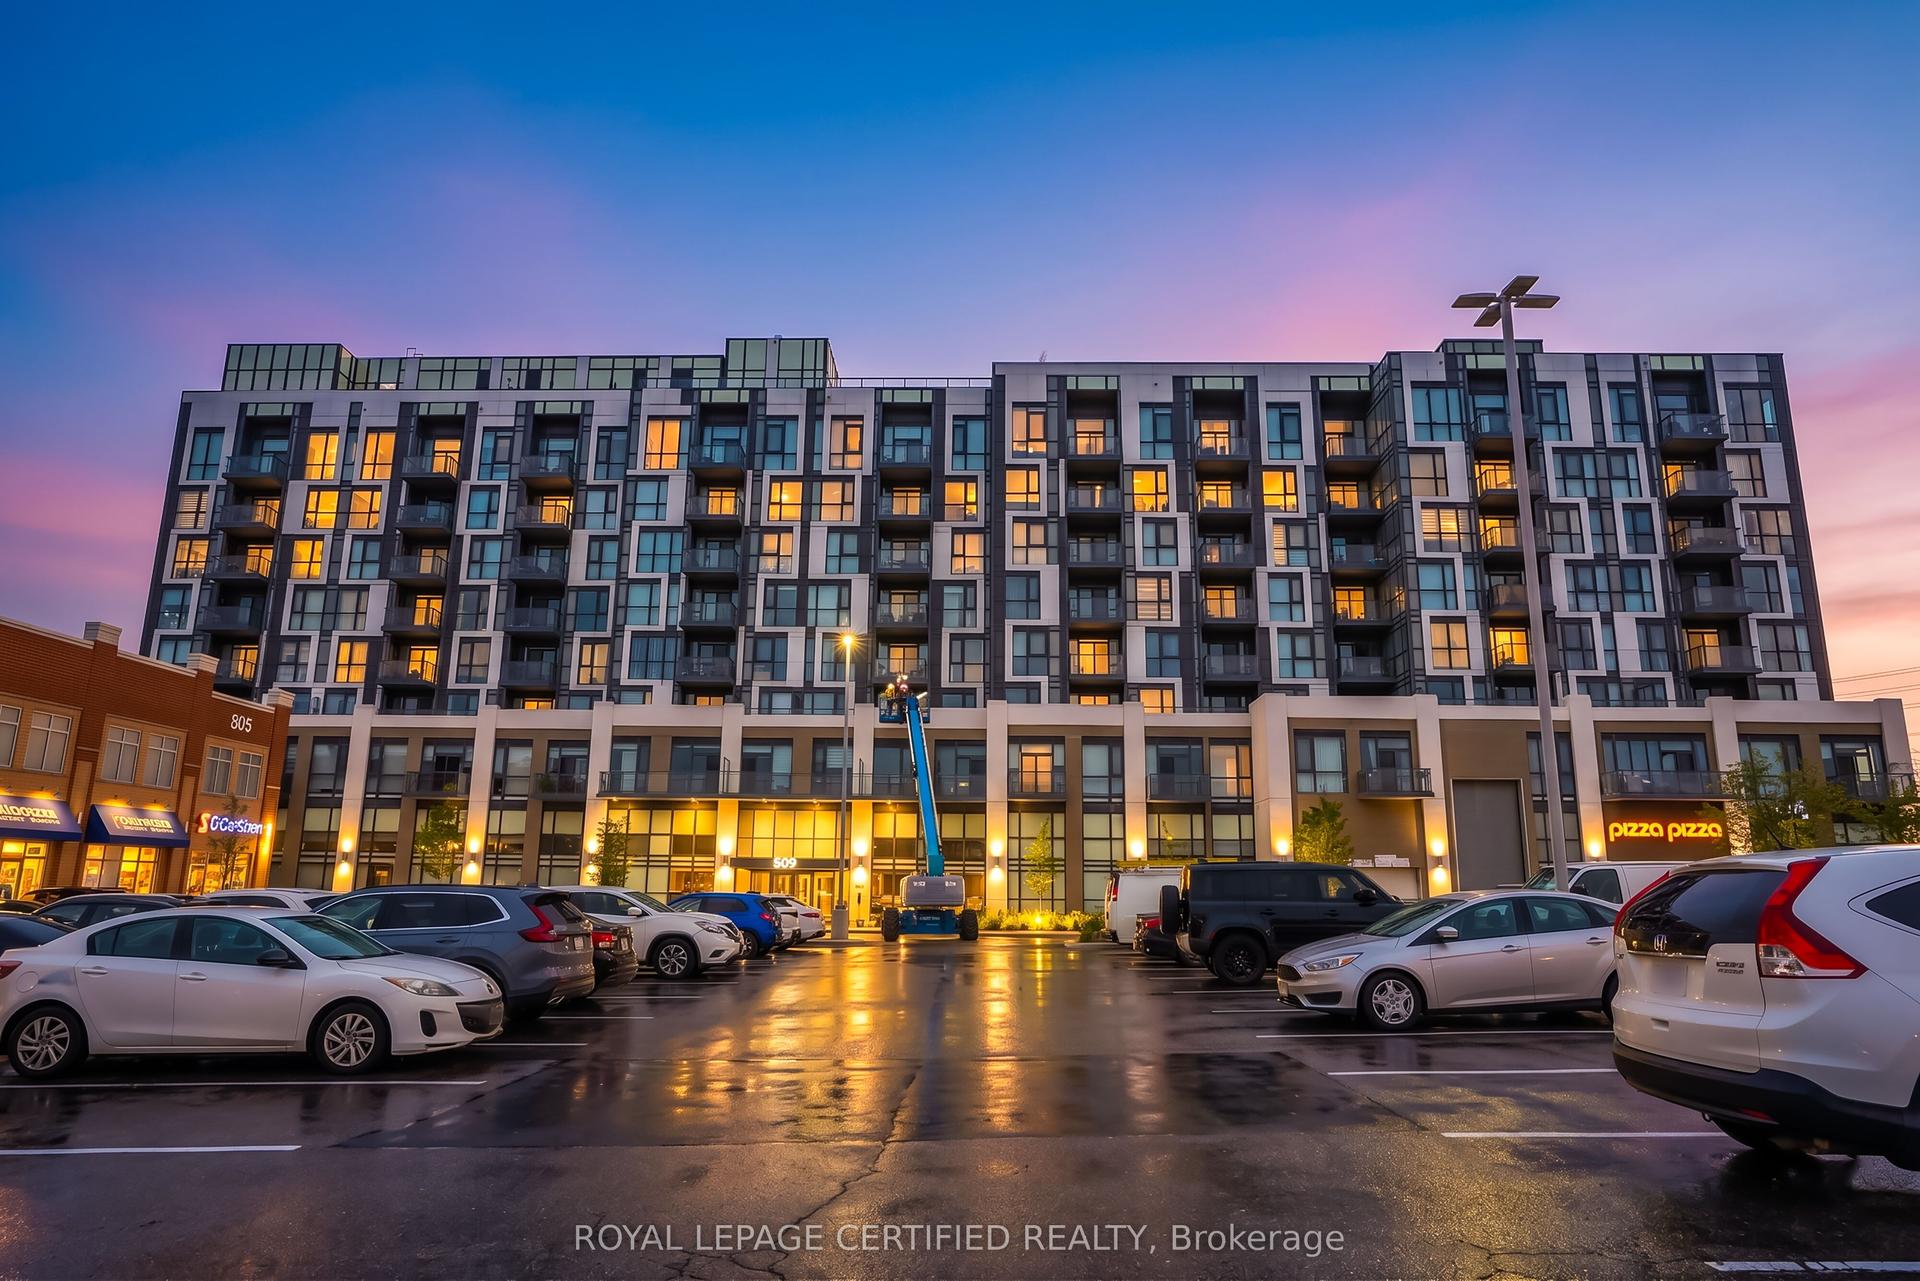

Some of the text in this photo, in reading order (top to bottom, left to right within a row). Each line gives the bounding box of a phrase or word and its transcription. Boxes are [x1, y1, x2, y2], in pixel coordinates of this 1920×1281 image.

[230, 714, 253, 733] 805
[1608, 822, 1723, 842] pizza pizza
[773, 857, 797, 869] 509
